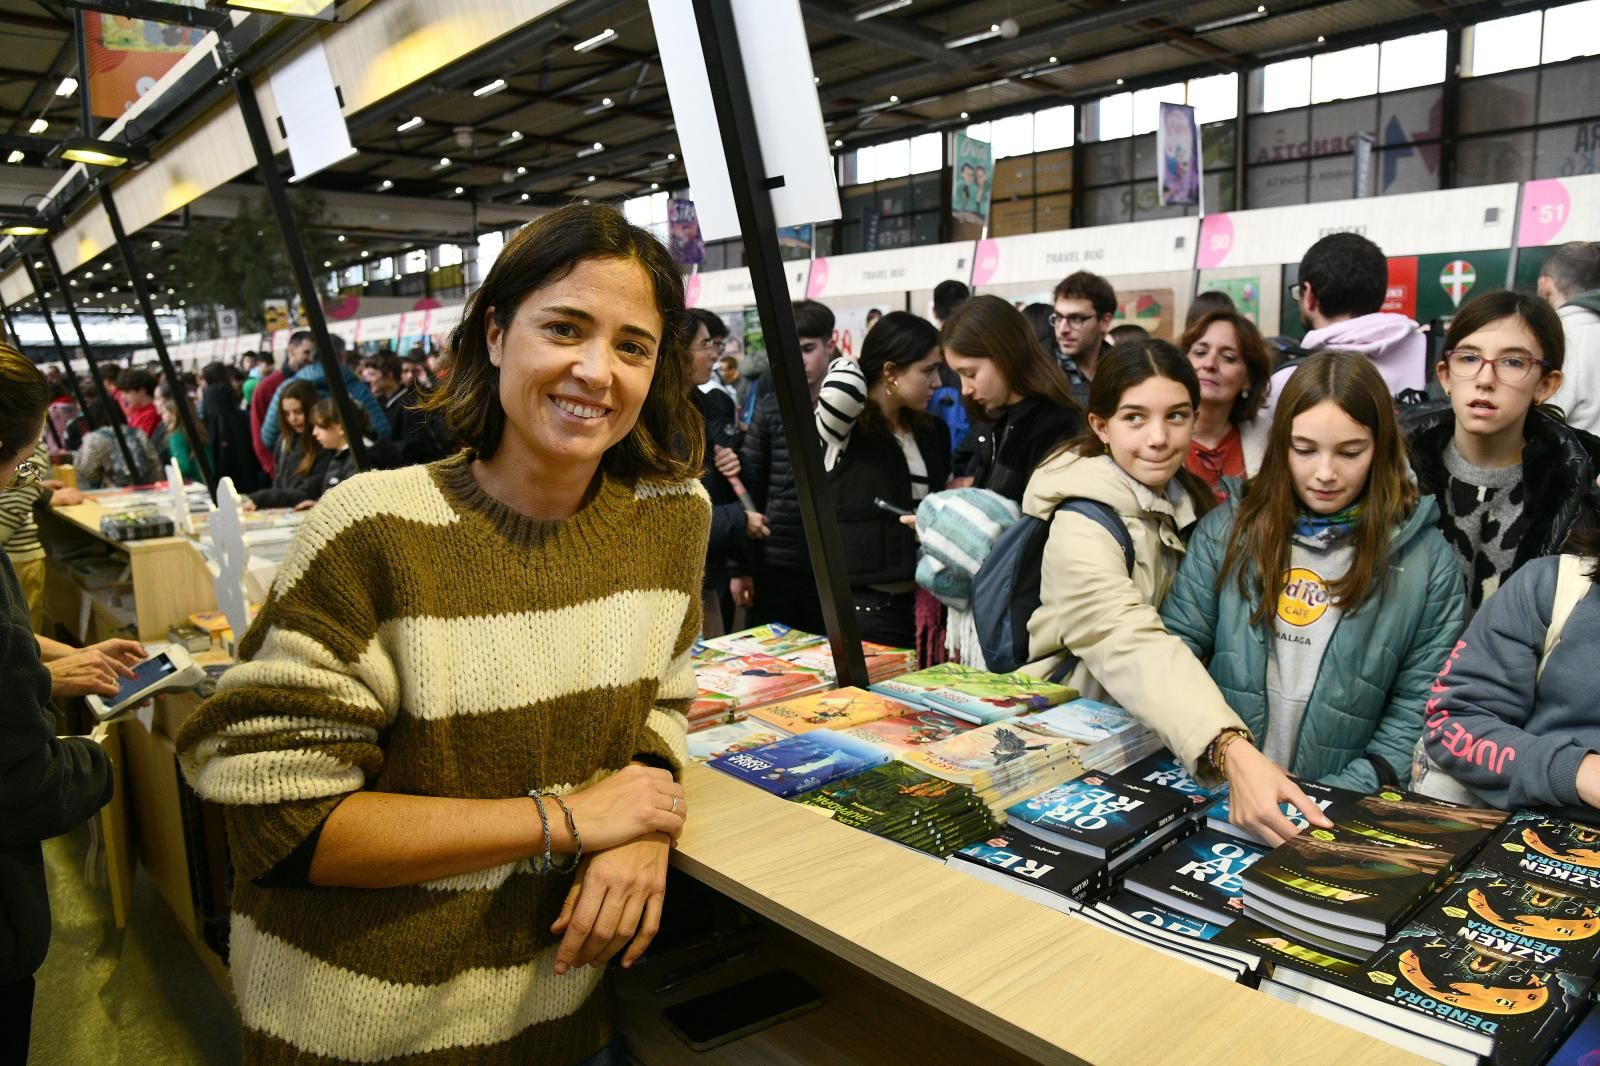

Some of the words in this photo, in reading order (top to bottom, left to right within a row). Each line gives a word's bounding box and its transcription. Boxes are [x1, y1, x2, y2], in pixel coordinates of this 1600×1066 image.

[1538, 204, 1566, 225] 51
[1211, 235, 1230, 249] 50
[1046, 251, 1080, 264] TRAVEL
[1083, 249, 1104, 262] BUG
[813, 795, 873, 823] TAUPADAK
[1086, 788, 1145, 812] RE
[987, 851, 1055, 880] RE
[1175, 860, 1243, 893] RE
[1456, 926, 1554, 964] AZKEN
[1467, 919, 1562, 957] DENBORA
[1393, 987, 1500, 1034] DENBORA
